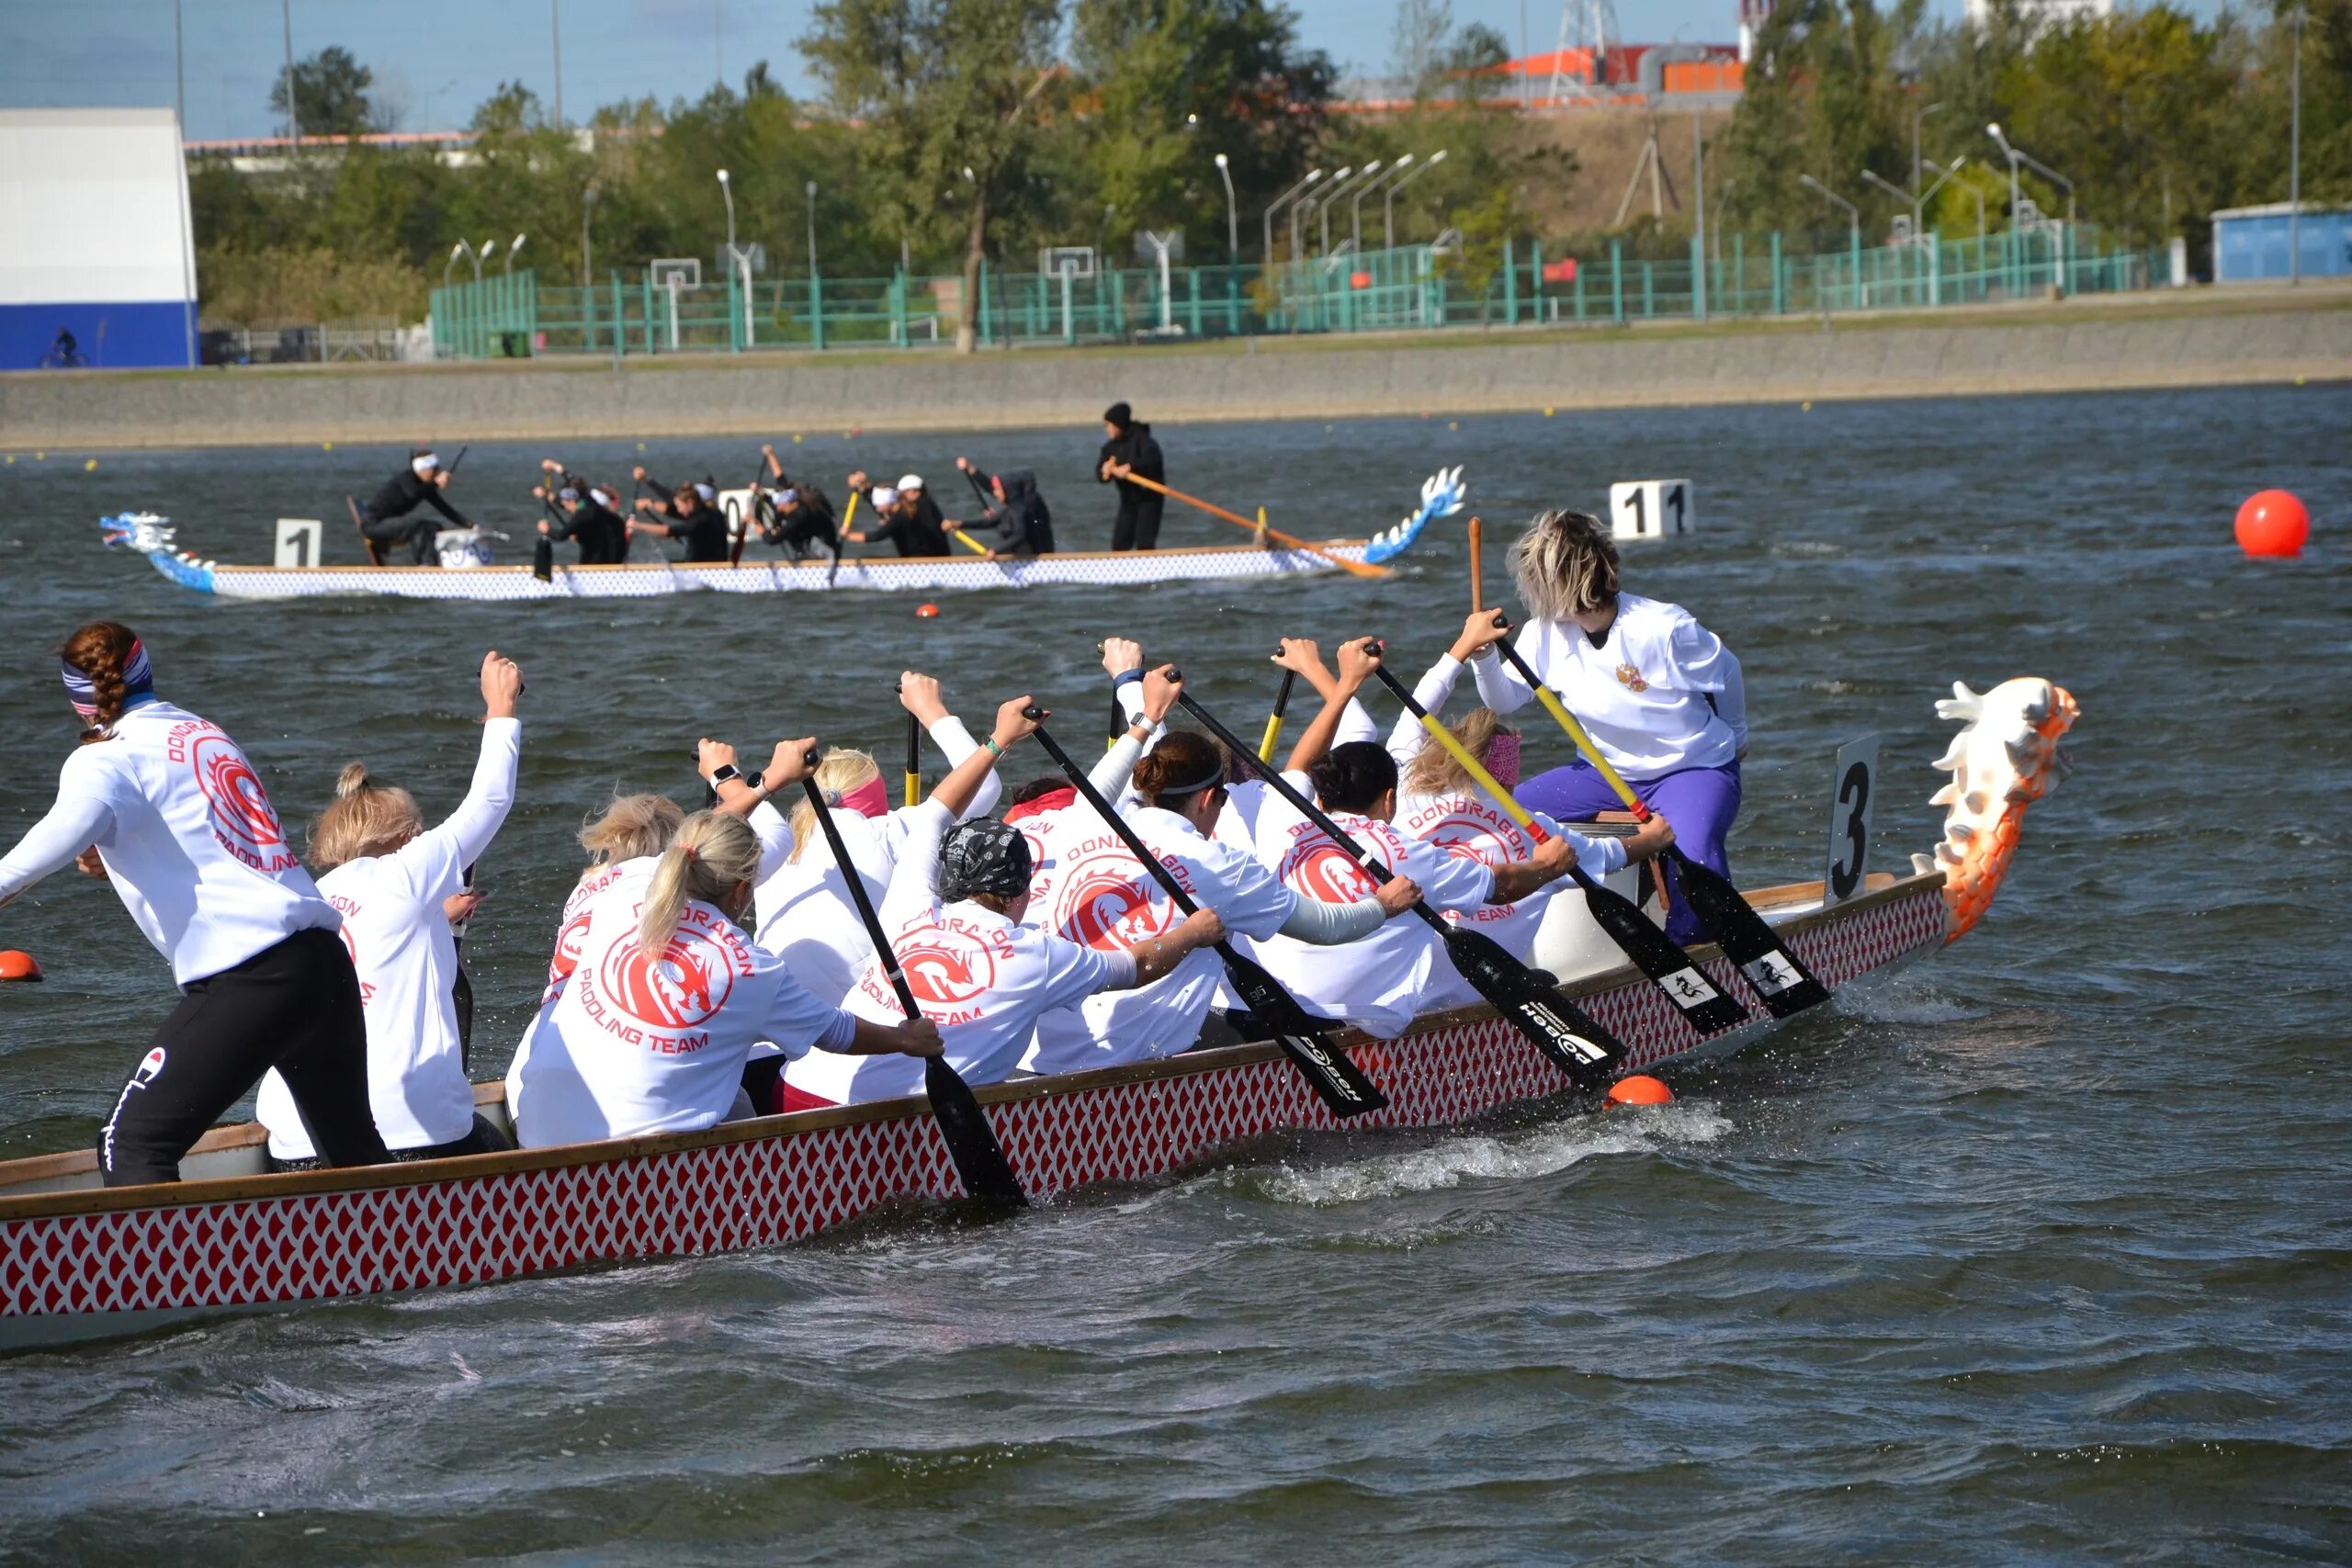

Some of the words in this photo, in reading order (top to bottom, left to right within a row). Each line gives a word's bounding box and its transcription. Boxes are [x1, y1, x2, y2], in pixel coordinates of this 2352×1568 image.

[286, 526, 310, 567] 1
[1408, 800, 1528, 862] DONDRAGON
[1831, 761, 1870, 899] 3
[580, 968, 643, 1044] PADDLING
[649, 1032, 708, 1054] TEAM
